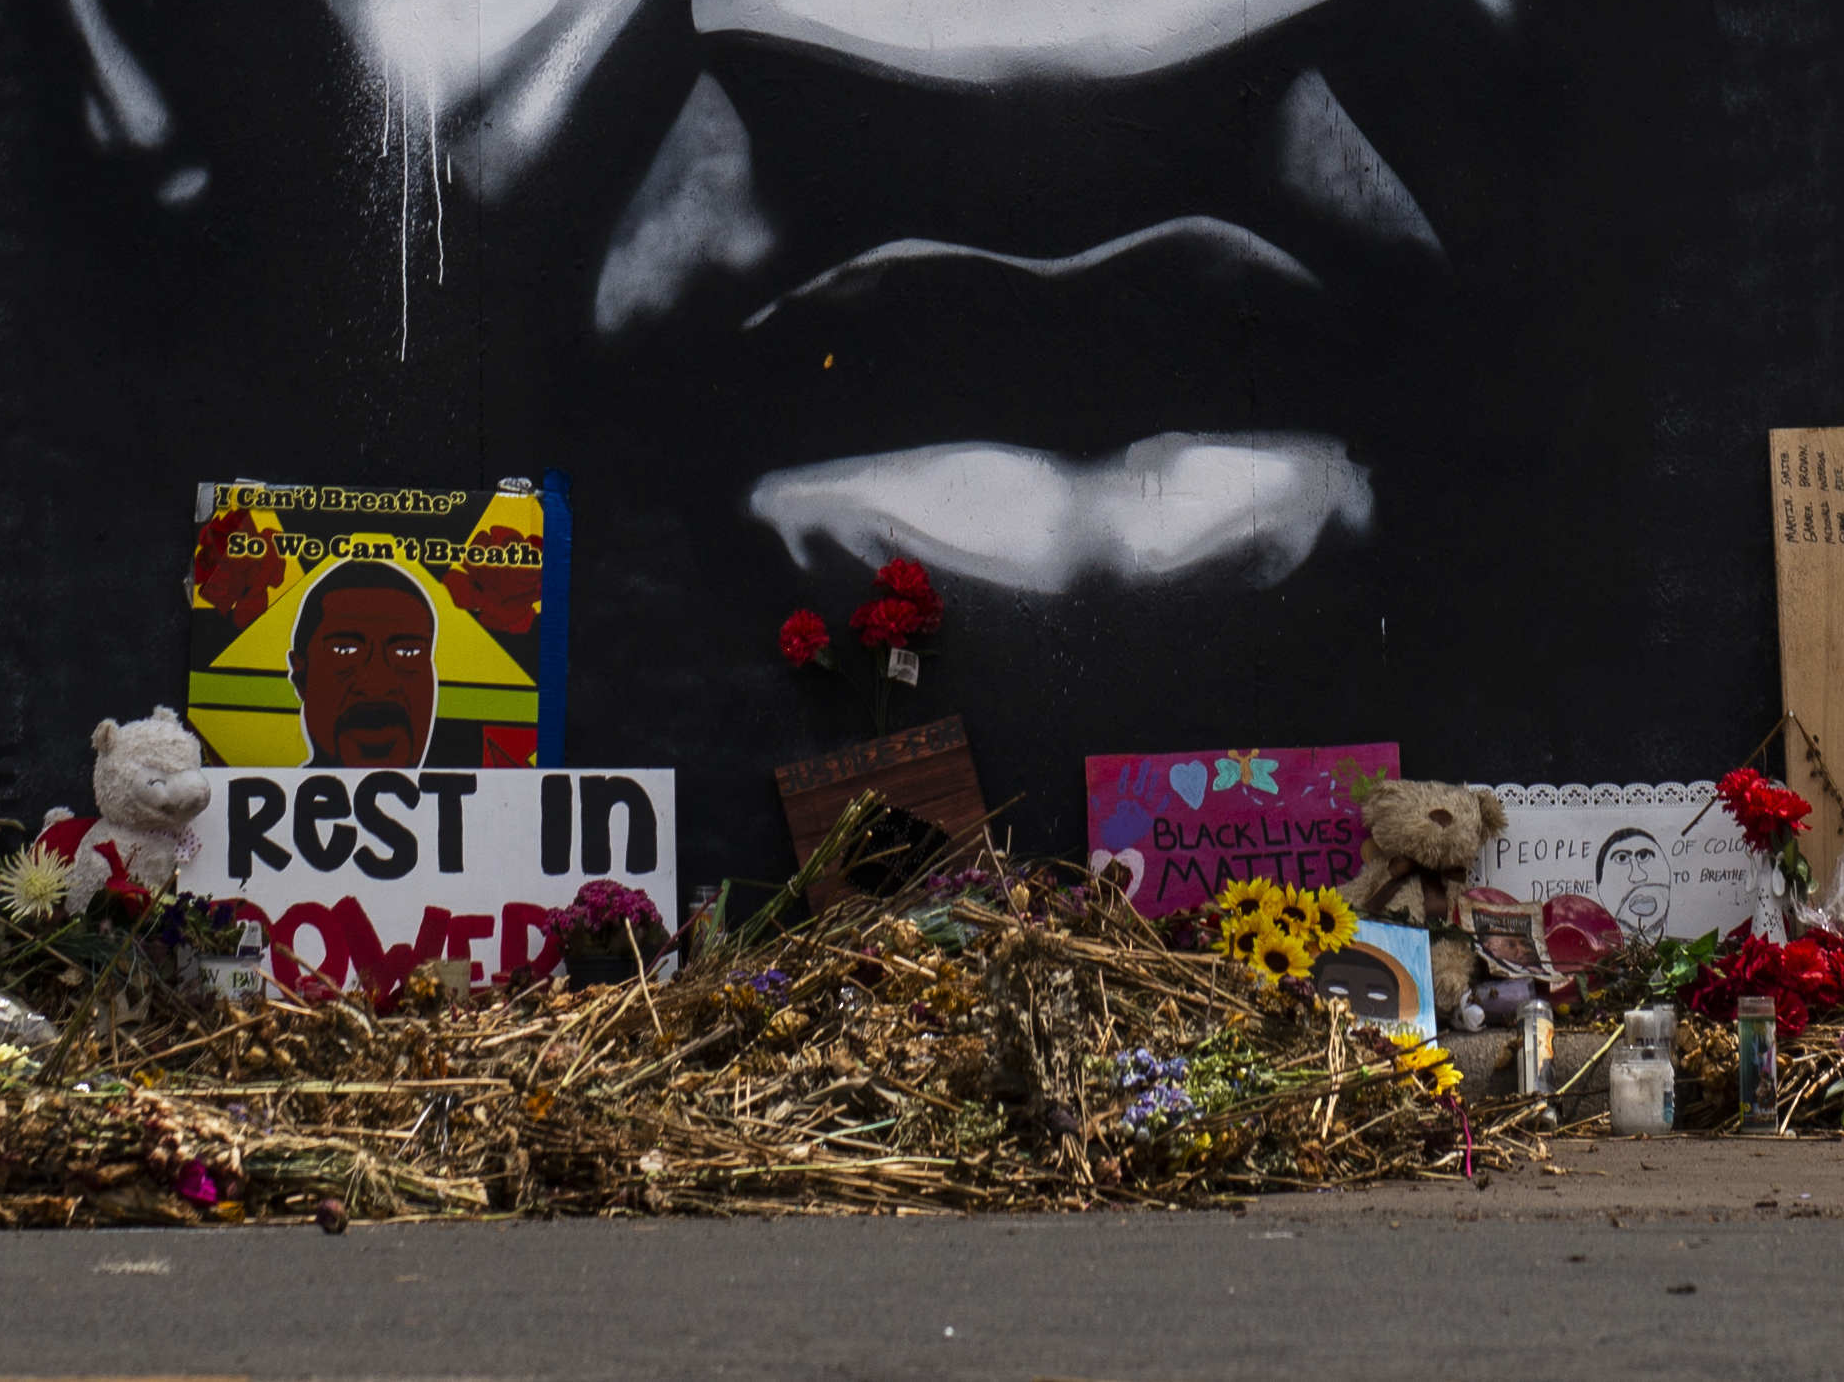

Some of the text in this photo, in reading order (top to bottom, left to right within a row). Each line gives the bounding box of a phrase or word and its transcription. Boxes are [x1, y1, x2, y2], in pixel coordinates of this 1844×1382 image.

[226, 531, 267, 559] So
[272, 532, 324, 560] We
[424, 539, 543, 567] Breath
[1153, 816, 1354, 852] BLACK LIVES
[1496, 838, 1593, 870] PEOPLE
[1671, 839, 1697, 856] OF
[1531, 867, 1747, 902] DESERVE TO BREATHE
